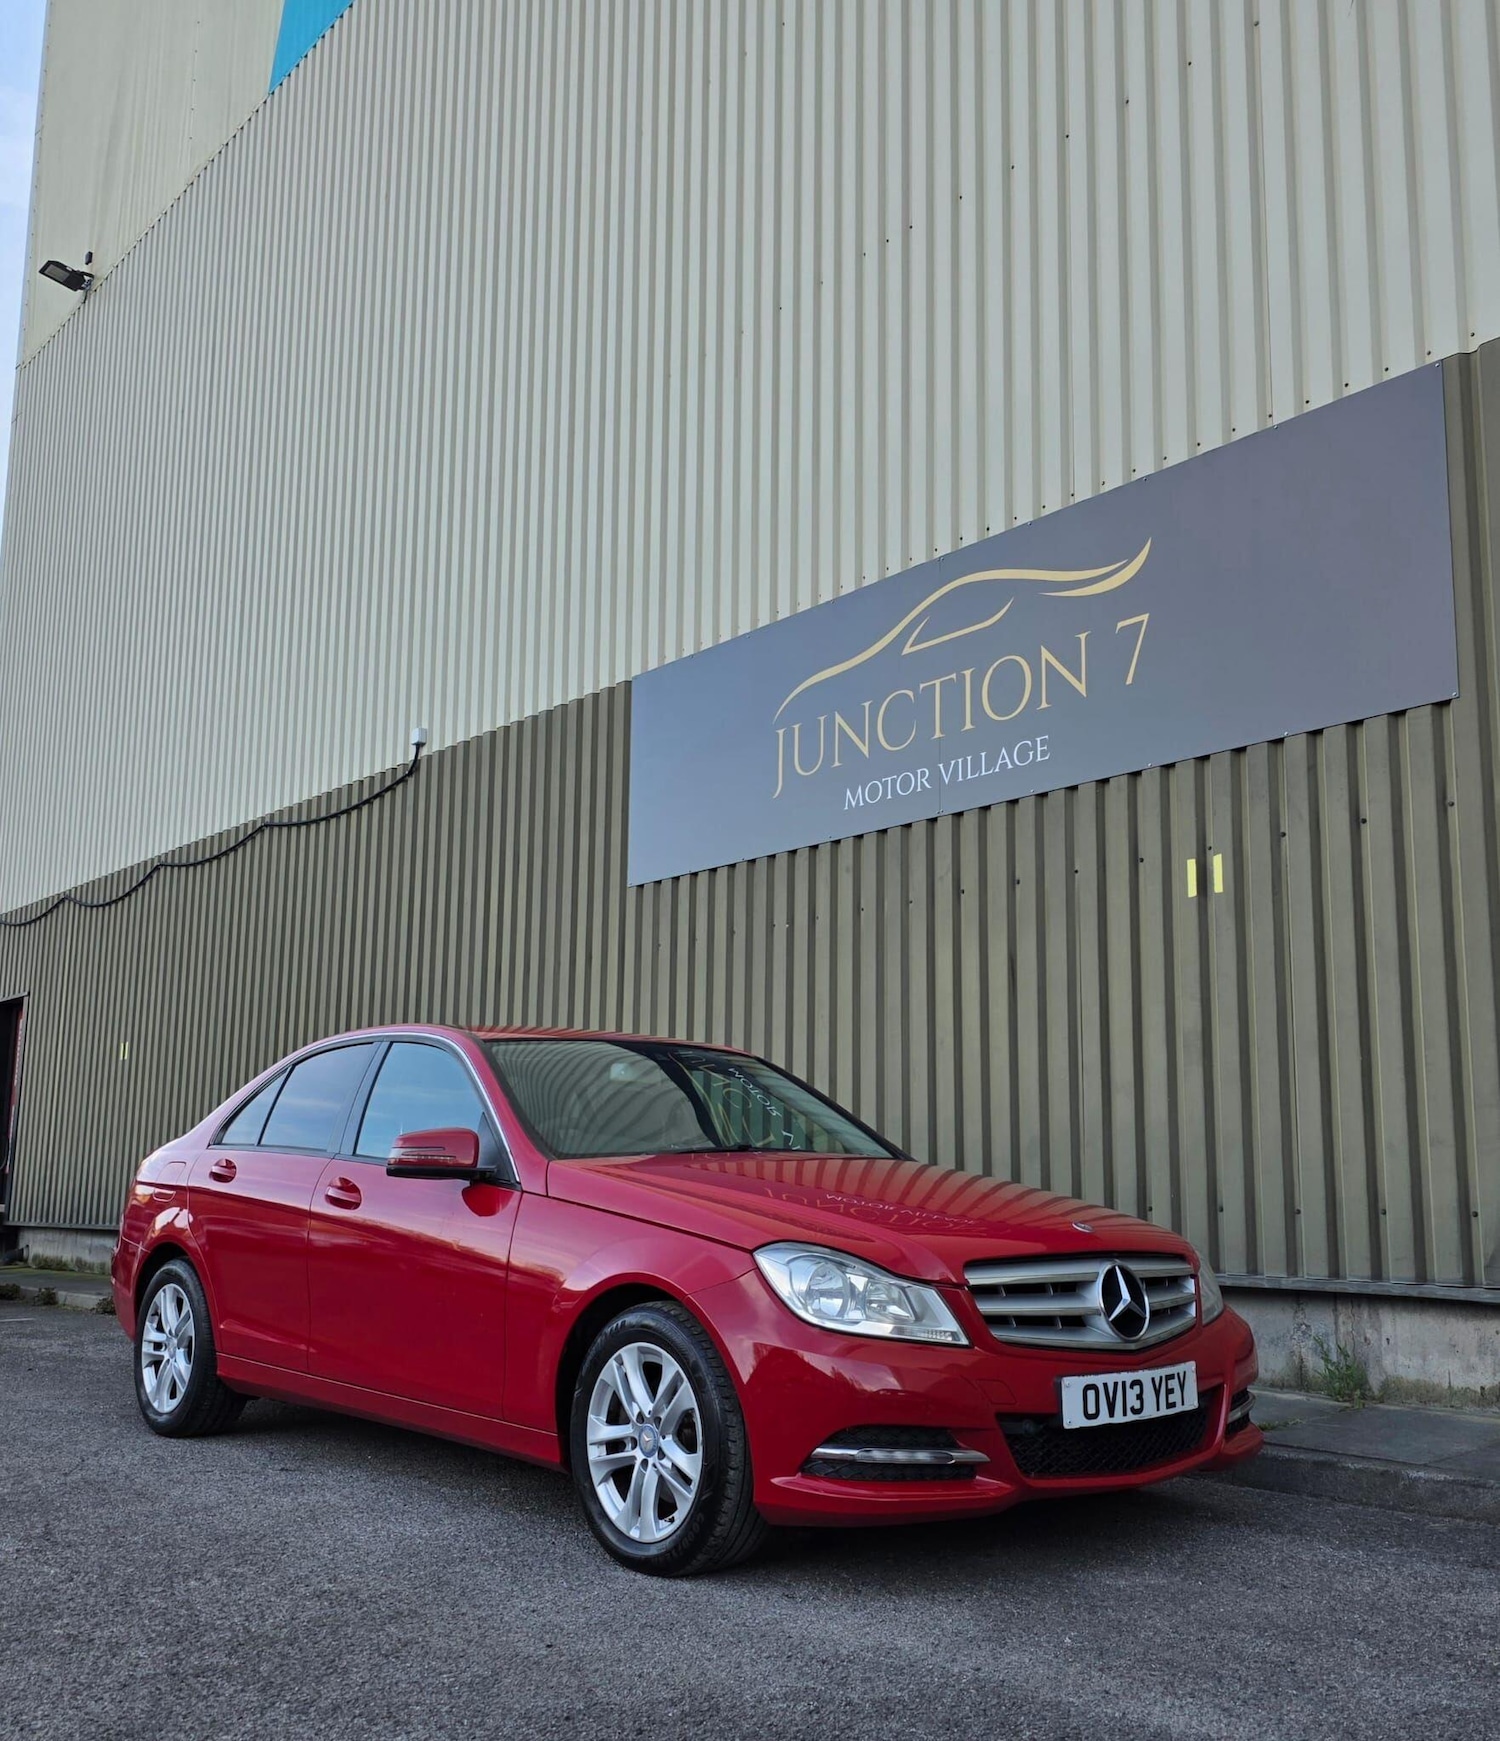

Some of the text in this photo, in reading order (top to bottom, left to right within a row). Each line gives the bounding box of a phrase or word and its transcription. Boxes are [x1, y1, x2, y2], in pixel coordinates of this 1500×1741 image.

[772, 612, 1150, 800] JUNCTION 7
[843, 735, 1051, 811] MOTOR VILLAGE
[1082, 1370, 1187, 1421] OV13 YEY
